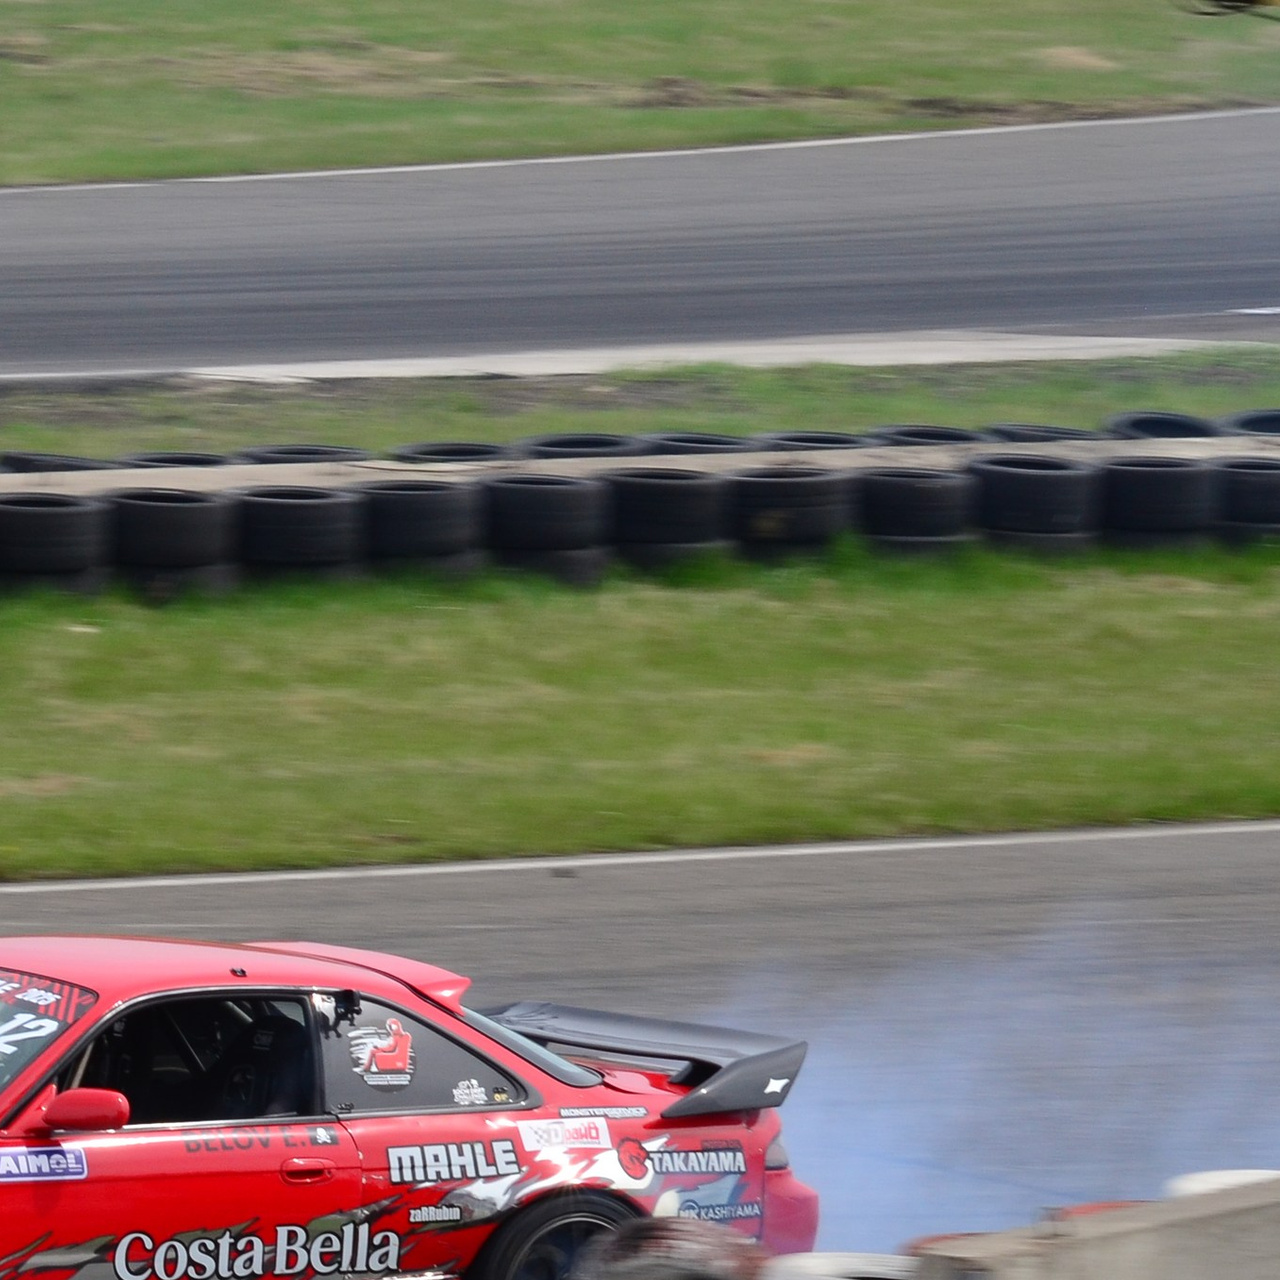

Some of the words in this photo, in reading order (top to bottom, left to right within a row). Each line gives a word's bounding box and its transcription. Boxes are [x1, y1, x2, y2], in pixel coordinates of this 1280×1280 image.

[182, 1126, 270, 1153] BELOV
[281, 1126, 306, 1147] E.
[387, 1140, 520, 1182] MAHLE
[651, 1151, 746, 1172] TAKAYAMA
[700, 1203, 761, 1220] KASHIYAMA
[272, 1222, 400, 1275] Bella
